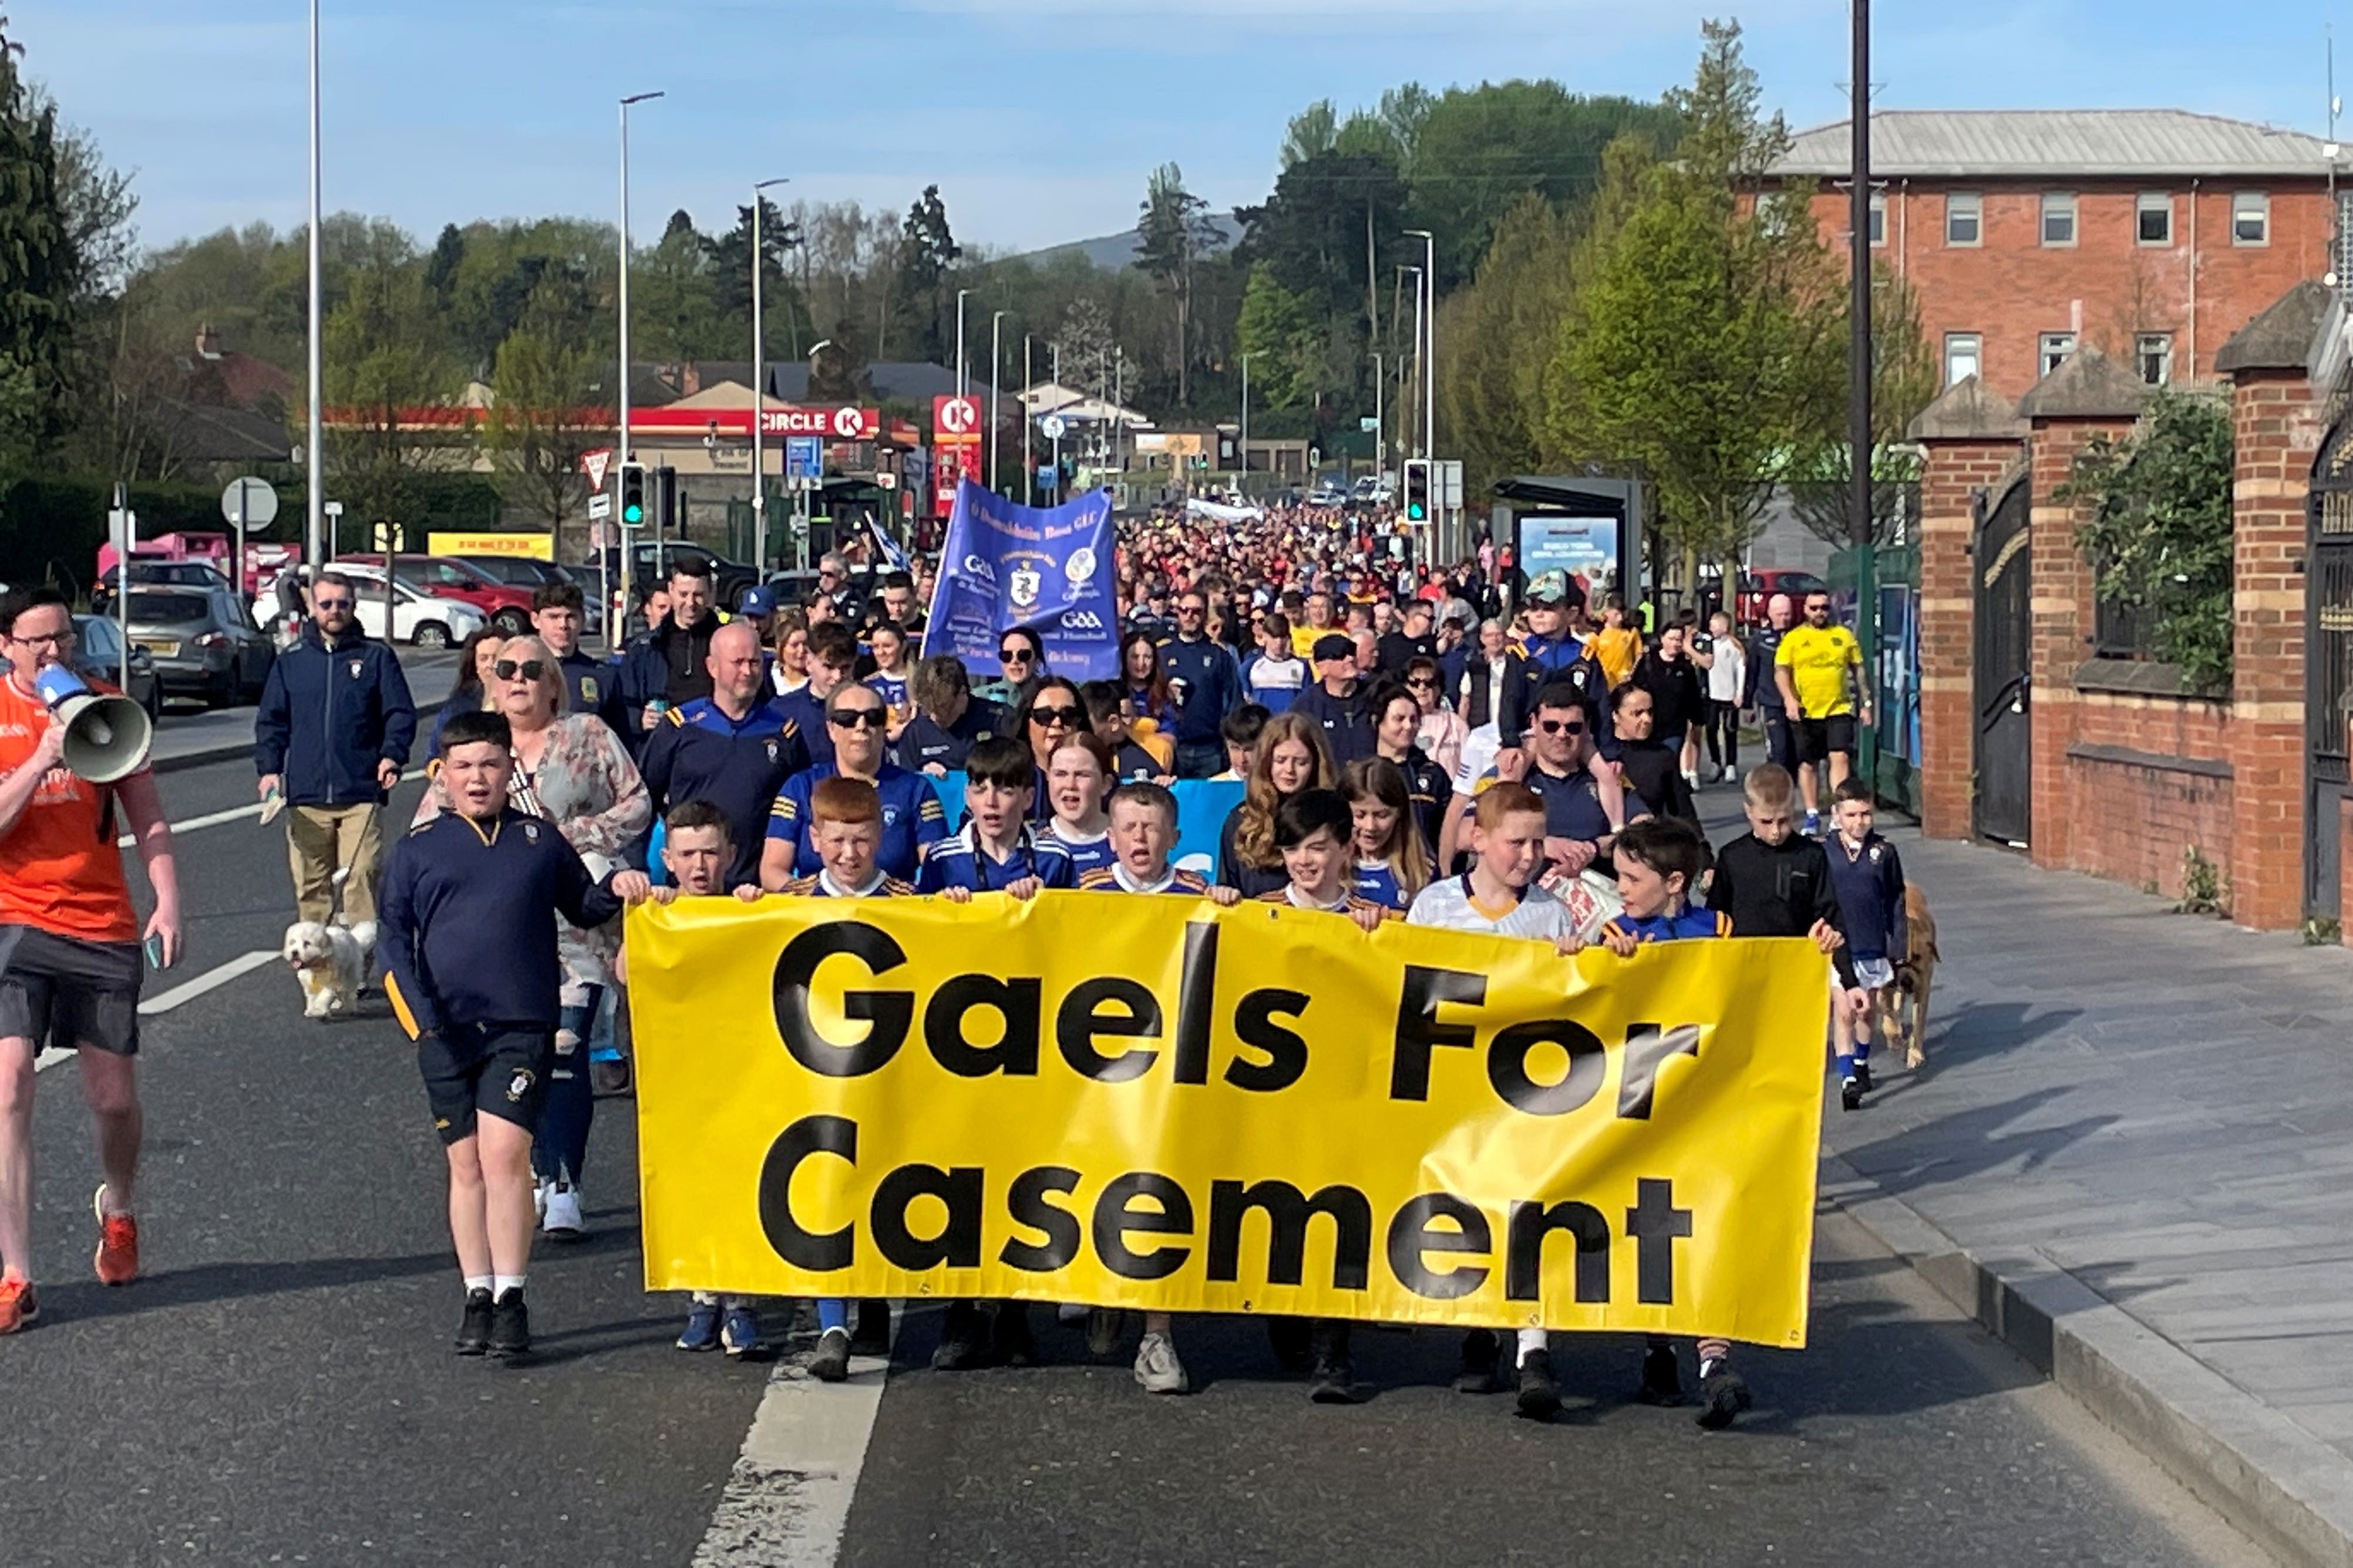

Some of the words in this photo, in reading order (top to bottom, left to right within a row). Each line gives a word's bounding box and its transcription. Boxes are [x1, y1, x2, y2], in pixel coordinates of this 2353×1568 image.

[761, 413, 826, 431] CIRCLE
[840, 410, 860, 435] K
[1061, 610, 1103, 629] GAA
[772, 919, 1311, 1092] Gaels
[1390, 964, 1702, 1119] For
[759, 1114, 1693, 1304] Casement
